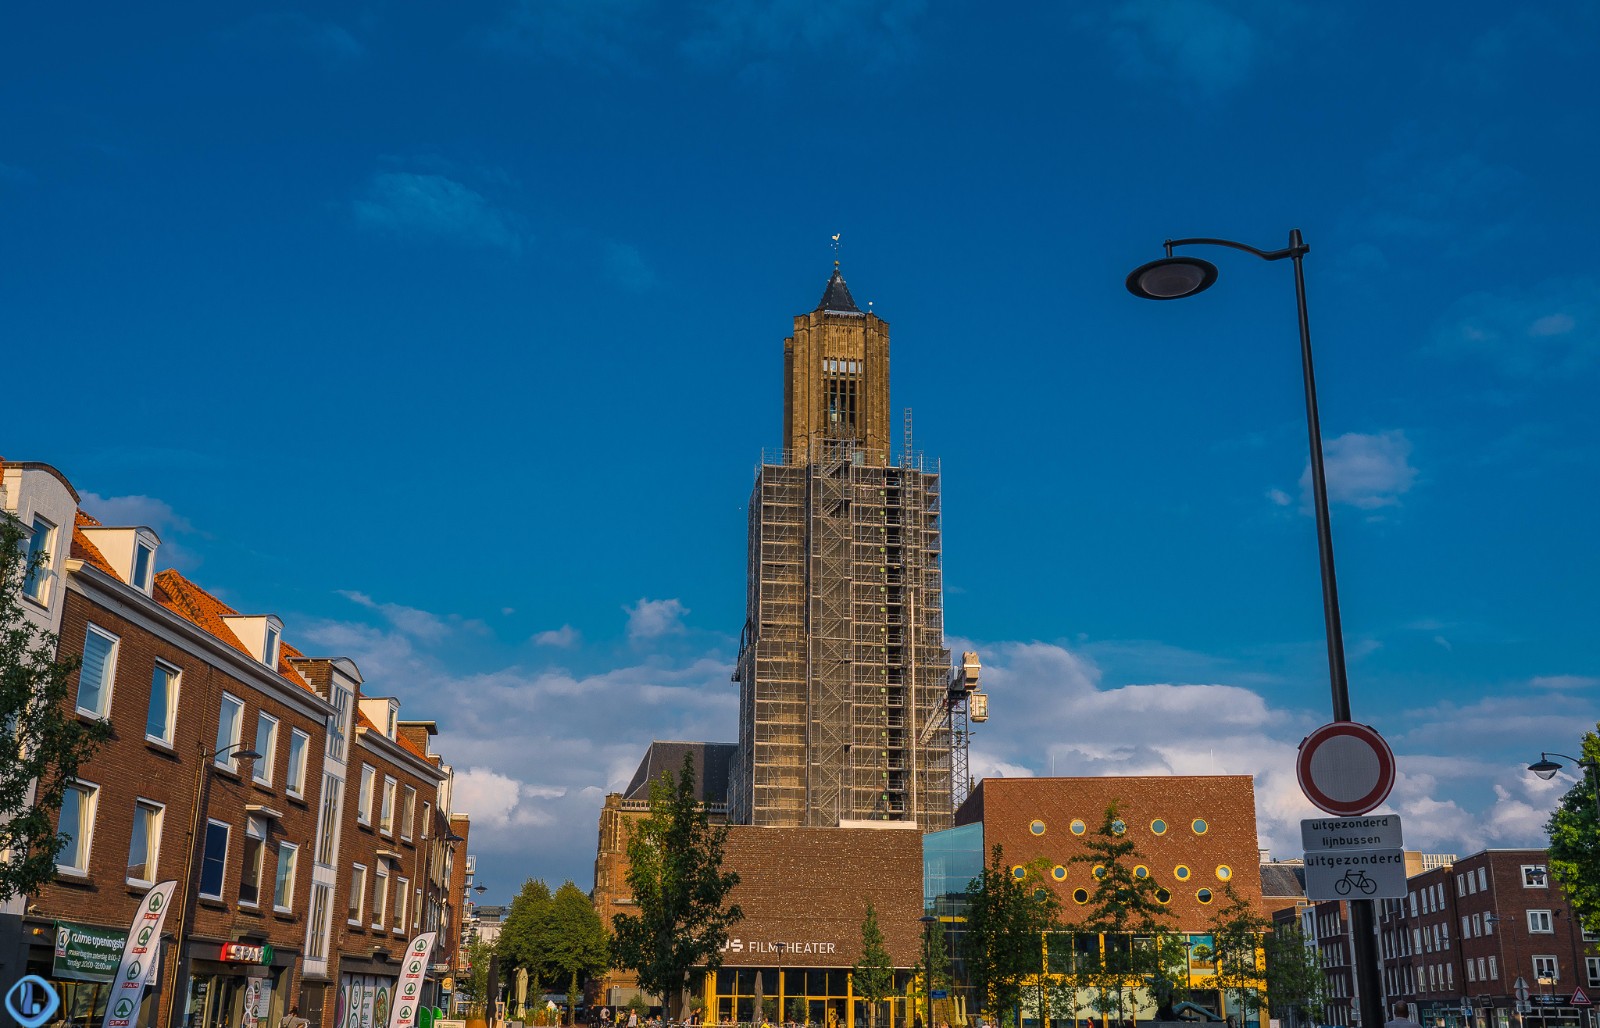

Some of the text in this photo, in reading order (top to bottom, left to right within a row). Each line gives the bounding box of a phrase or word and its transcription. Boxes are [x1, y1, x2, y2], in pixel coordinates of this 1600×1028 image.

[1312, 818, 1388, 831] uitgezonderd
[1322, 836, 1381, 848] lijnbussen
[1307, 854, 1401, 868] uitgezonderd
[71, 931, 92, 946] ruime
[230, 944, 264, 962] SPAR
